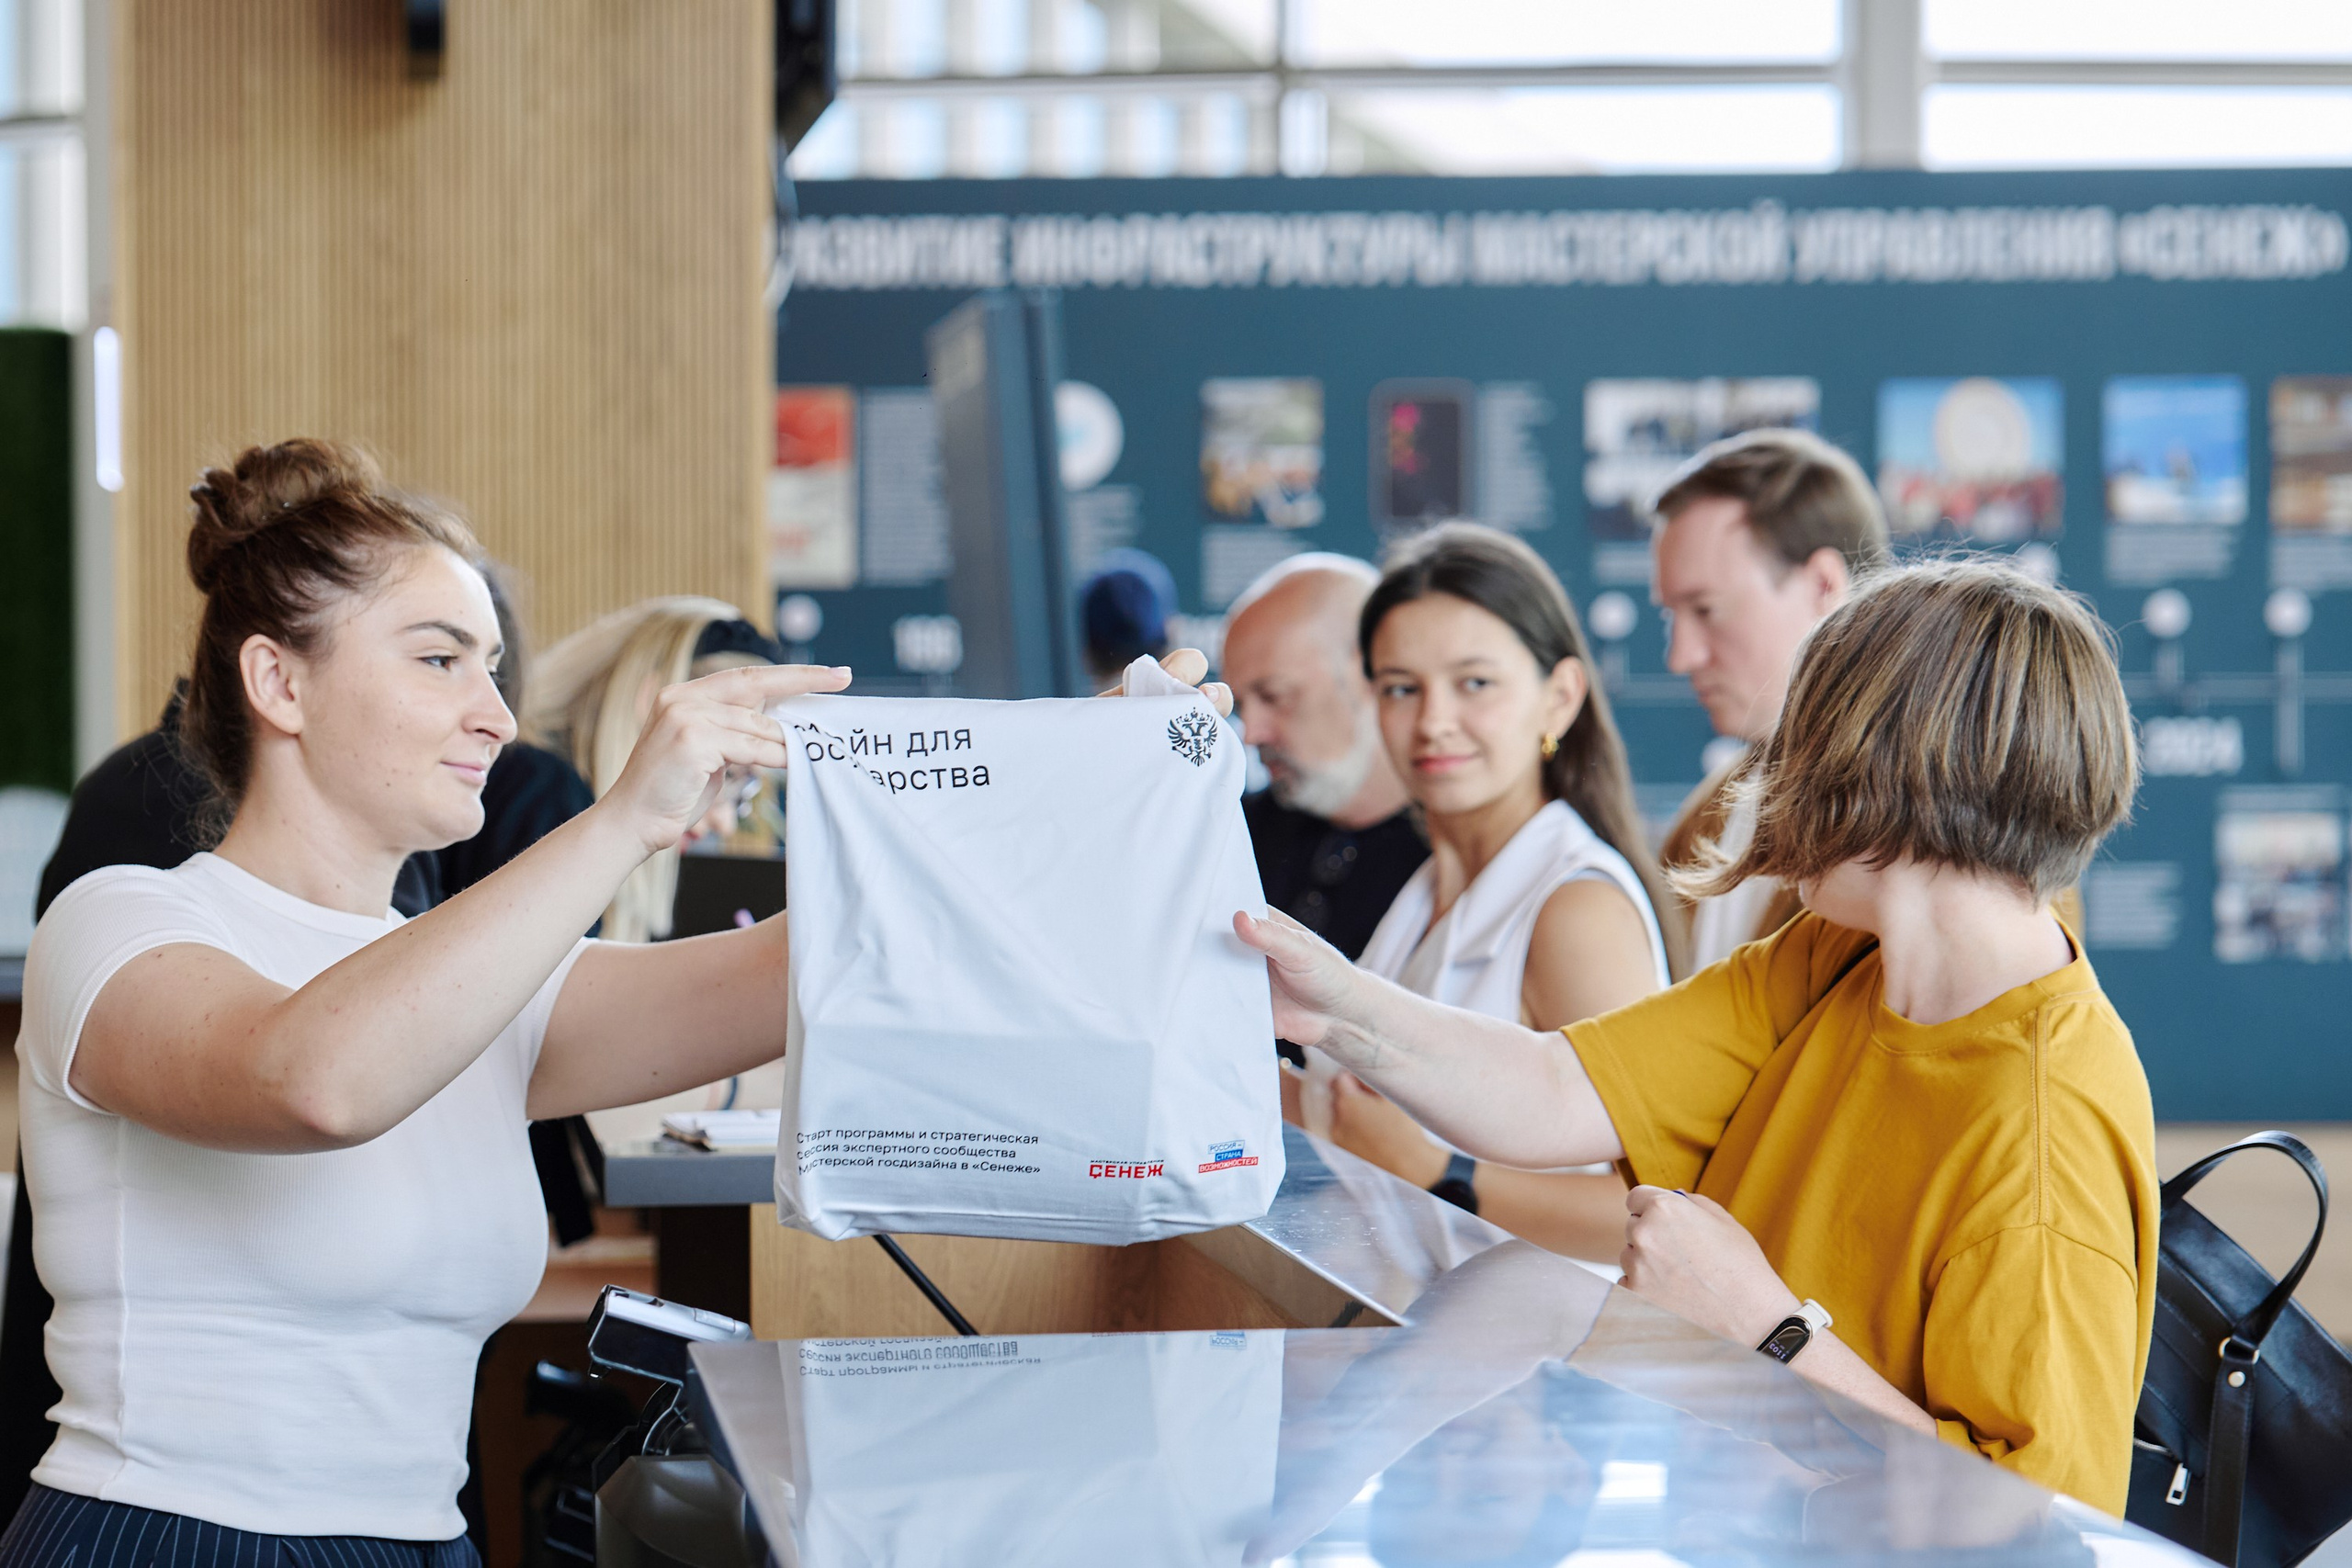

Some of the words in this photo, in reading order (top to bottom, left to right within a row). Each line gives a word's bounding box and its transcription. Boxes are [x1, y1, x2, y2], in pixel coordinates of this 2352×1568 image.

[907, 728, 971, 758] для
[797, 1129, 832, 1144] Старт
[836, 1128, 915, 1140] программы
[919, 1130, 927, 1139] и
[931, 1131, 1038, 1145] стратегическая
[797, 1144, 839, 1159] сессия
[842, 1144, 930, 1156] экспертного
[933, 1145, 1016, 1158] сообщества
[1210, 1142, 1237, 1152] РОССИЯ
[1216, 1150, 1241, 1161] СТРАНА
[878, 1156, 956, 1170] госдизайна
[961, 1162, 968, 1170] в
[973, 1161, 1040, 1174] «Сенеже»
[1090, 1164, 1163, 1179] СЕНЕЖ
[1199, 1157, 1258, 1172] ВОЗМОЖНОСТЕЙ
